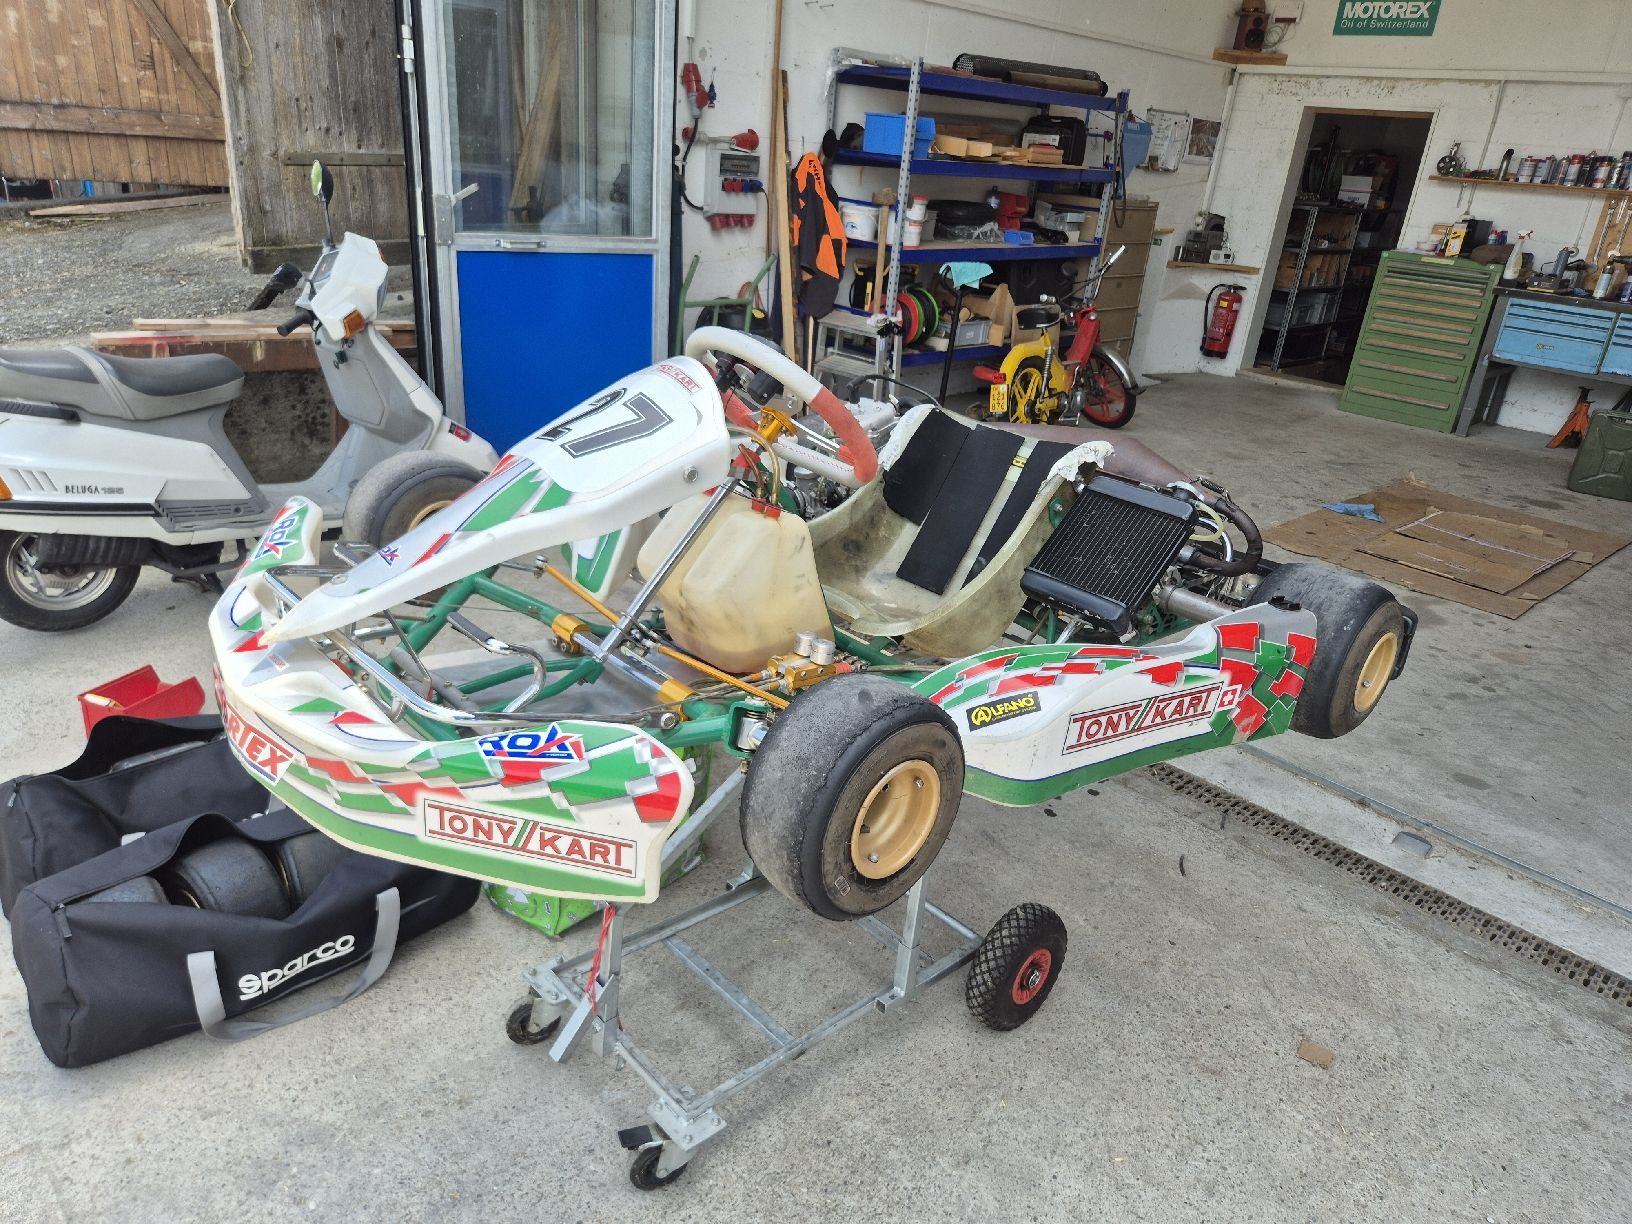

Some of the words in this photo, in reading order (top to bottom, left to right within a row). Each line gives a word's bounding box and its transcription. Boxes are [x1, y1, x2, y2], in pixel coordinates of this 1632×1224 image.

[1343, 1, 1433, 19] MOTOREX
[1341, 19, 1354, 28] Oil
[1357, 19, 1367, 28] of
[1370, 19, 1429, 28] Switzerland
[535, 387, 675, 459] 27
[65, 485, 100, 494] BELUGA
[971, 697, 1035, 726] ALFANO
